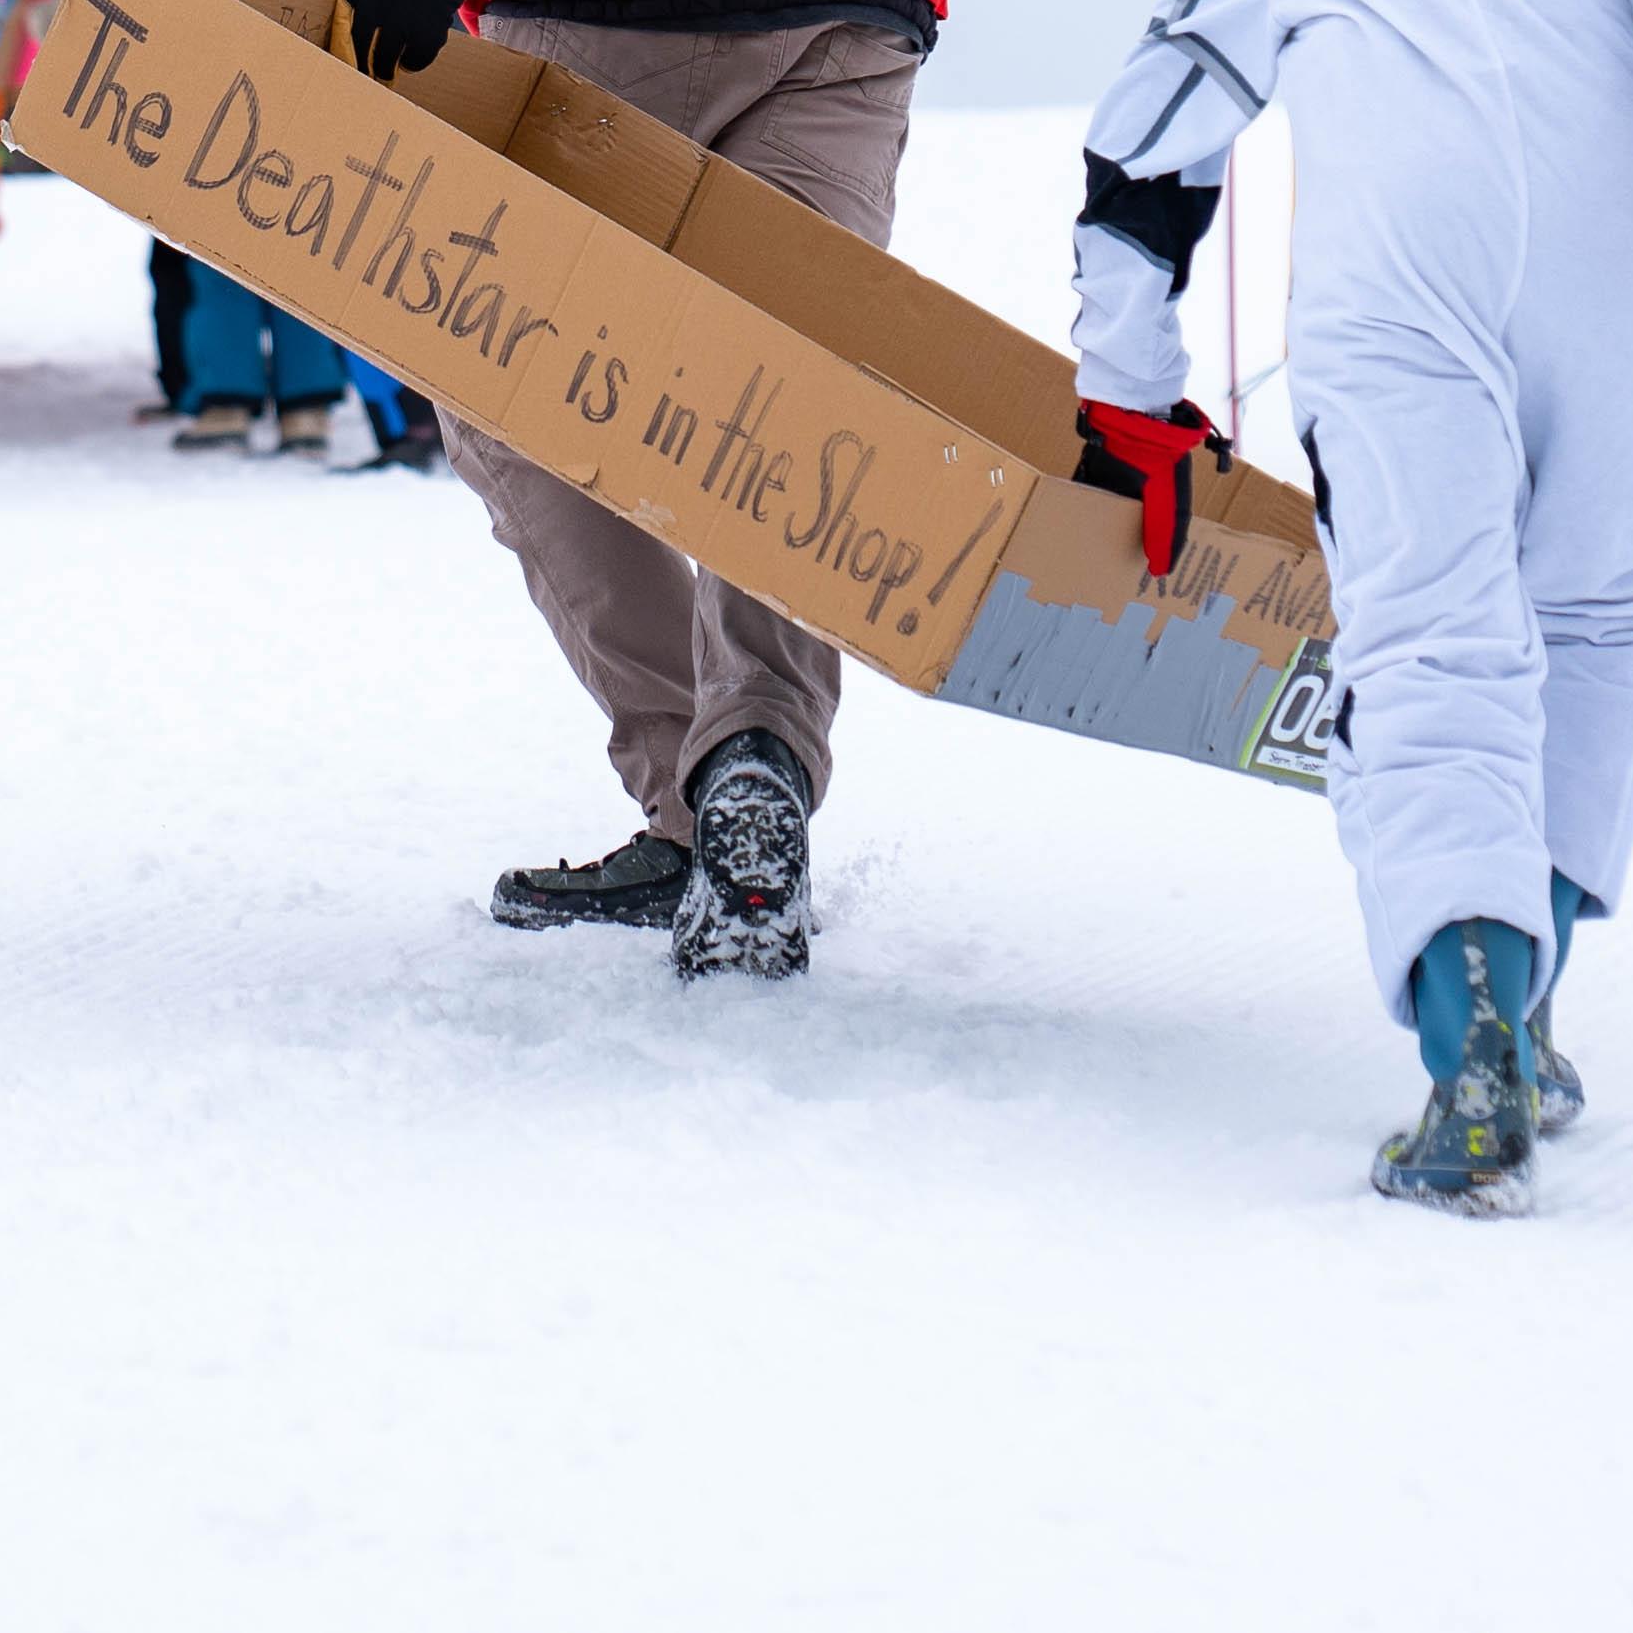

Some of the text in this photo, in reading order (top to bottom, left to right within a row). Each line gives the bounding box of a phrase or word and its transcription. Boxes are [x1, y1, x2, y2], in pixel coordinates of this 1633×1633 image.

[183, 68, 559, 369] Deathstar
[565, 324, 629, 423] is
[641, 367, 699, 466] in
[700, 364, 794, 523] the
[783, 429, 1004, 637] Shop!
